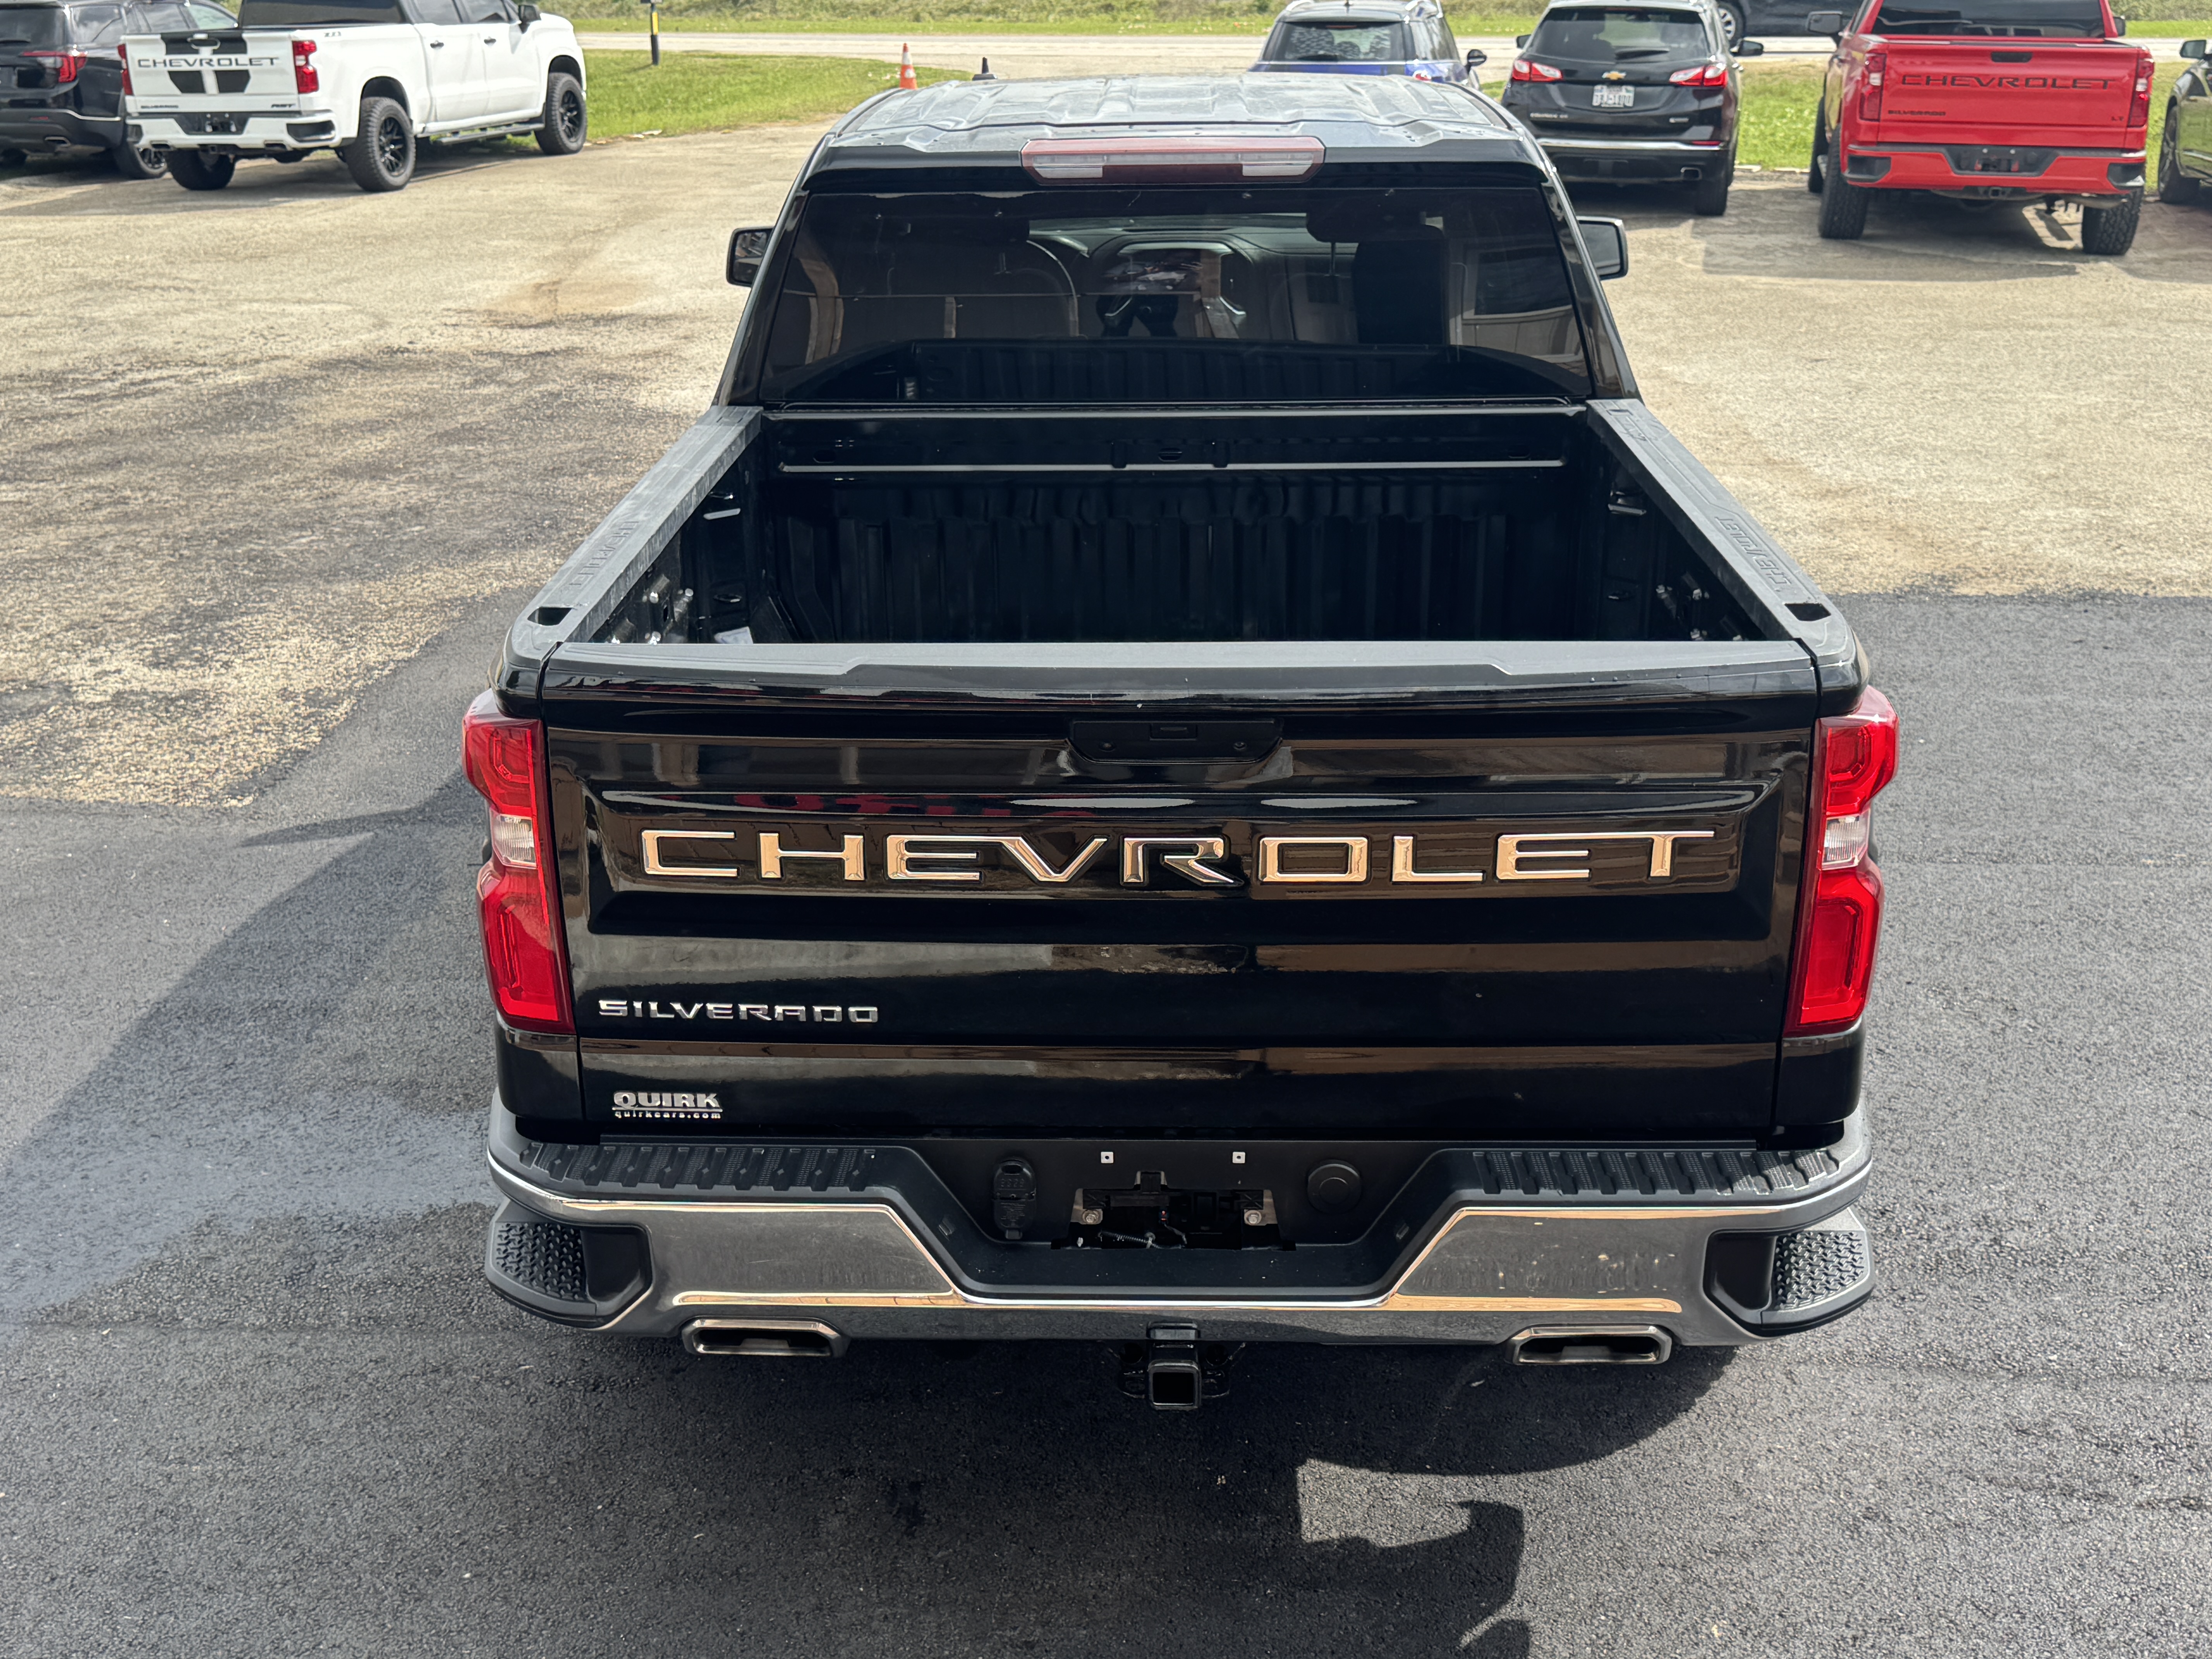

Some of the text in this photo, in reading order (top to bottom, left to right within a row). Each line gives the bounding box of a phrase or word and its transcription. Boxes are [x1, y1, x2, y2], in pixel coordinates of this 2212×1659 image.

[138, 57, 279, 68] CHEVROLET
[1902, 76, 2116, 90] CHEVROLET
[641, 830, 1715, 885] CHEVROLET
[599, 1000, 878, 1023] SILVERADO
[613, 1092, 720, 1109] QUIRK
[615, 1110, 721, 1119] quirkcars.com
